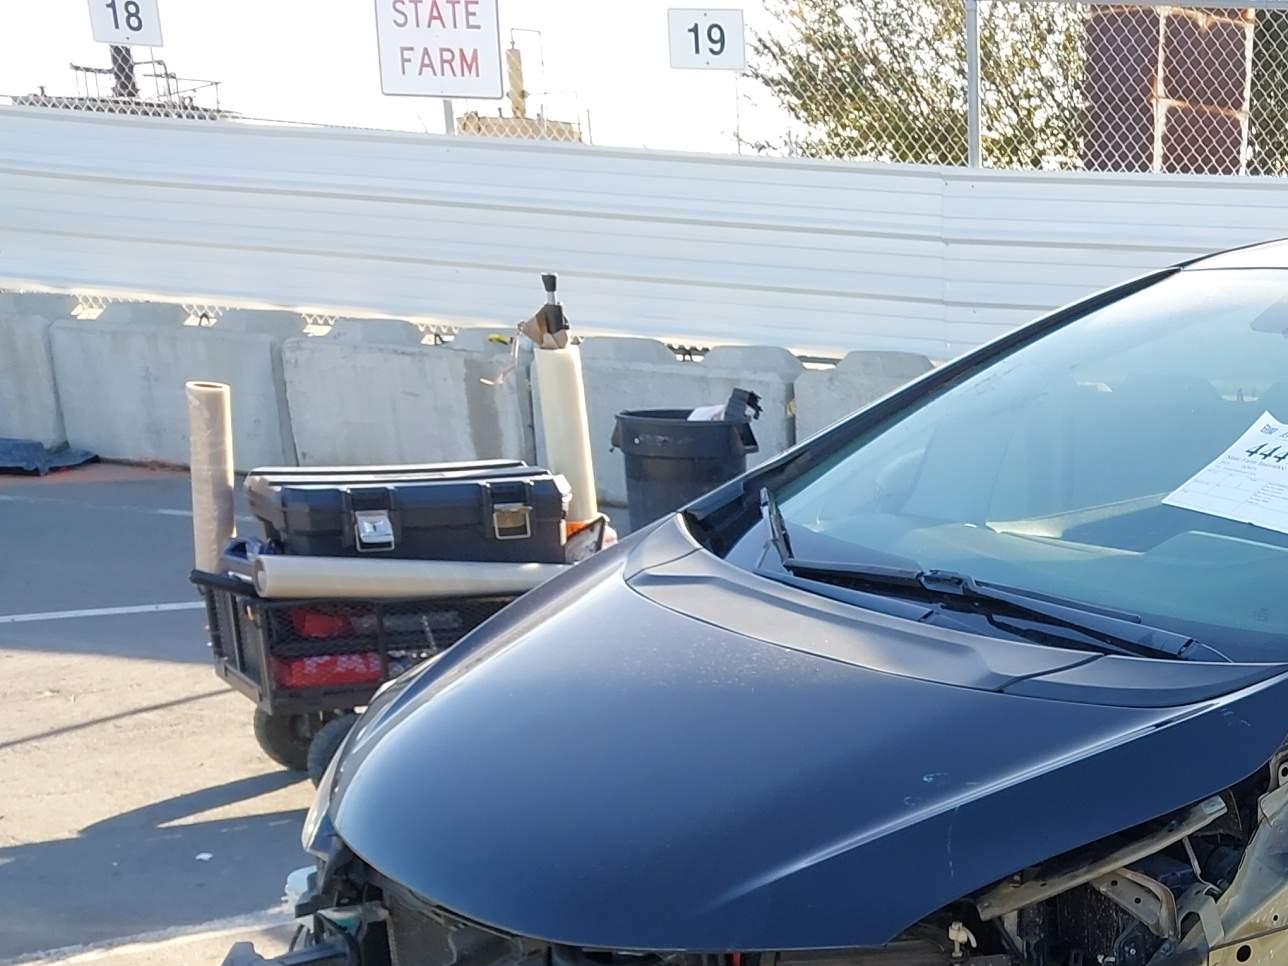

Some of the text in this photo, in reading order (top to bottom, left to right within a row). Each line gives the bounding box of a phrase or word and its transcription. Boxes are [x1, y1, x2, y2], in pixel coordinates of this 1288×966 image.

[105, 0, 143, 31] 18
[392, 0, 481, 29] STATE
[687, 22, 726, 56] 19
[399, 46, 480, 78] FARM
